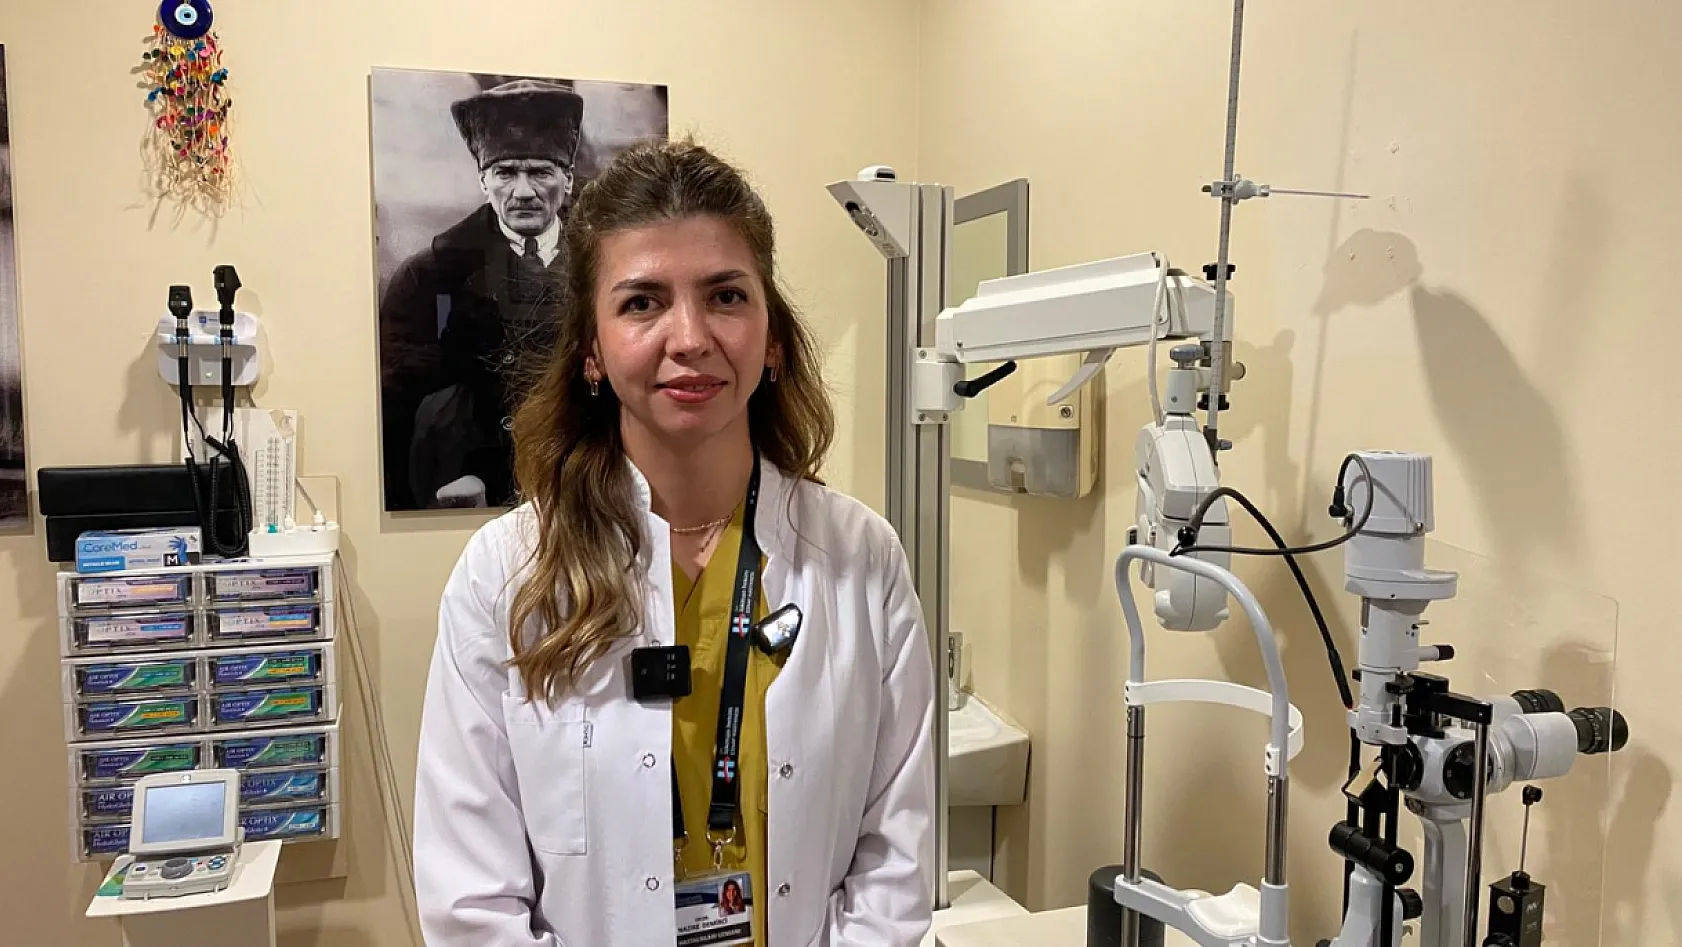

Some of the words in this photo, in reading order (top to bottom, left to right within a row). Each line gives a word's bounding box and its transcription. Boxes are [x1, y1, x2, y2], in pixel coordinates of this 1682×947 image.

[167, 555, 178, 565] M
[98, 793, 115, 801] AIR
[93, 830, 110, 839] AIR
